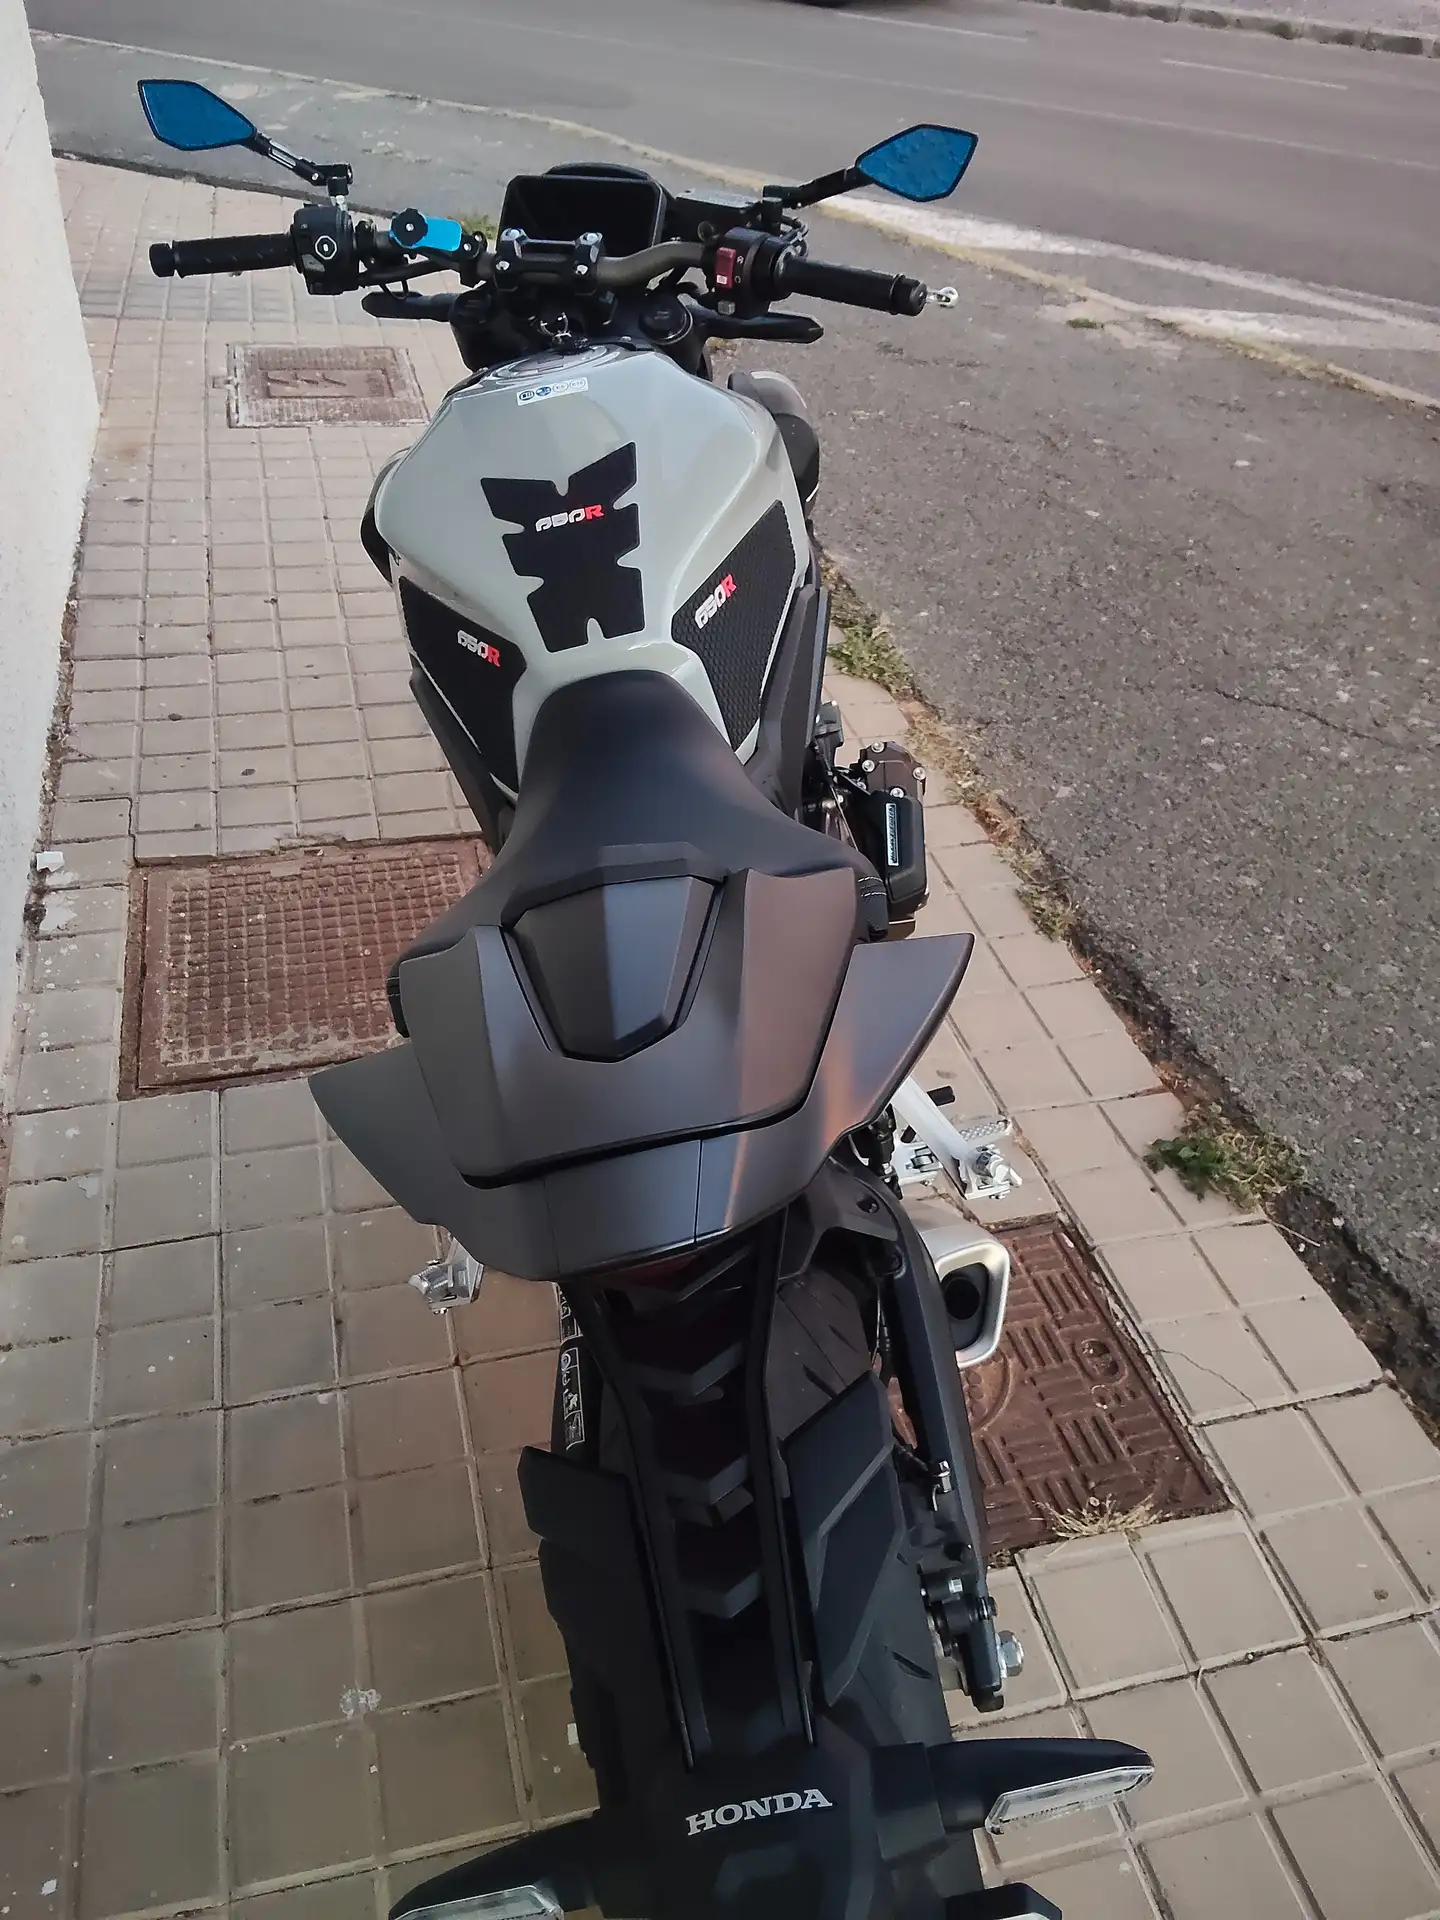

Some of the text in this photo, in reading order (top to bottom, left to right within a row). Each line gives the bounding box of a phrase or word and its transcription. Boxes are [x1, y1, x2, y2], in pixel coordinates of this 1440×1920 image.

[694, 573, 738, 629] 650R
[457, 629, 501, 667] 650R
[685, 1788, 833, 1836] HONDA
